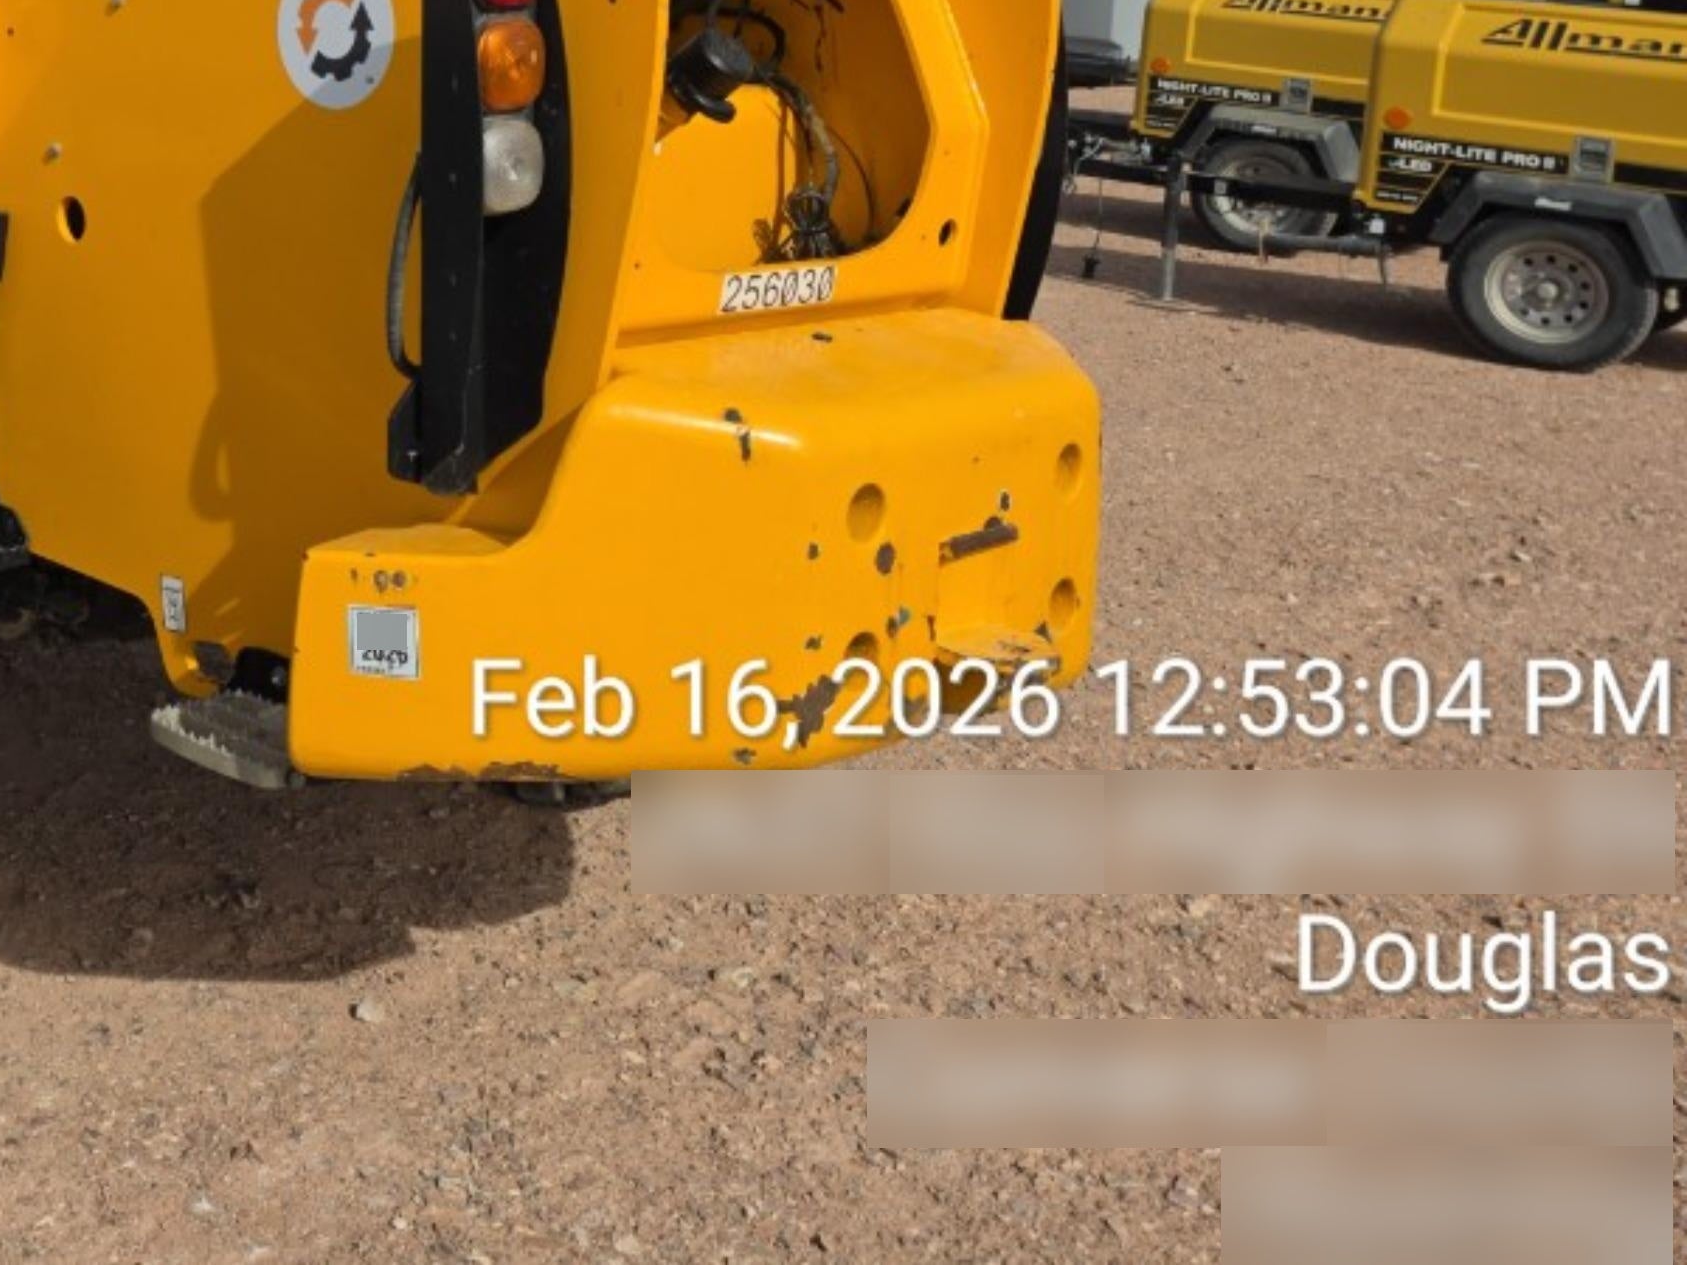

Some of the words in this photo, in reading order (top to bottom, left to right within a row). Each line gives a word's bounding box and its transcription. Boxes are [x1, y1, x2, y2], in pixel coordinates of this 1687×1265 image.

[1157, 77, 1230, 99] NIGHT-LITE
[1232, 88, 1260, 102] PRO
[1392, 136, 1499, 164] NIGHT-LITE
[1501, 150, 1539, 168] PRO
[720, 265, 835, 313] 256030
